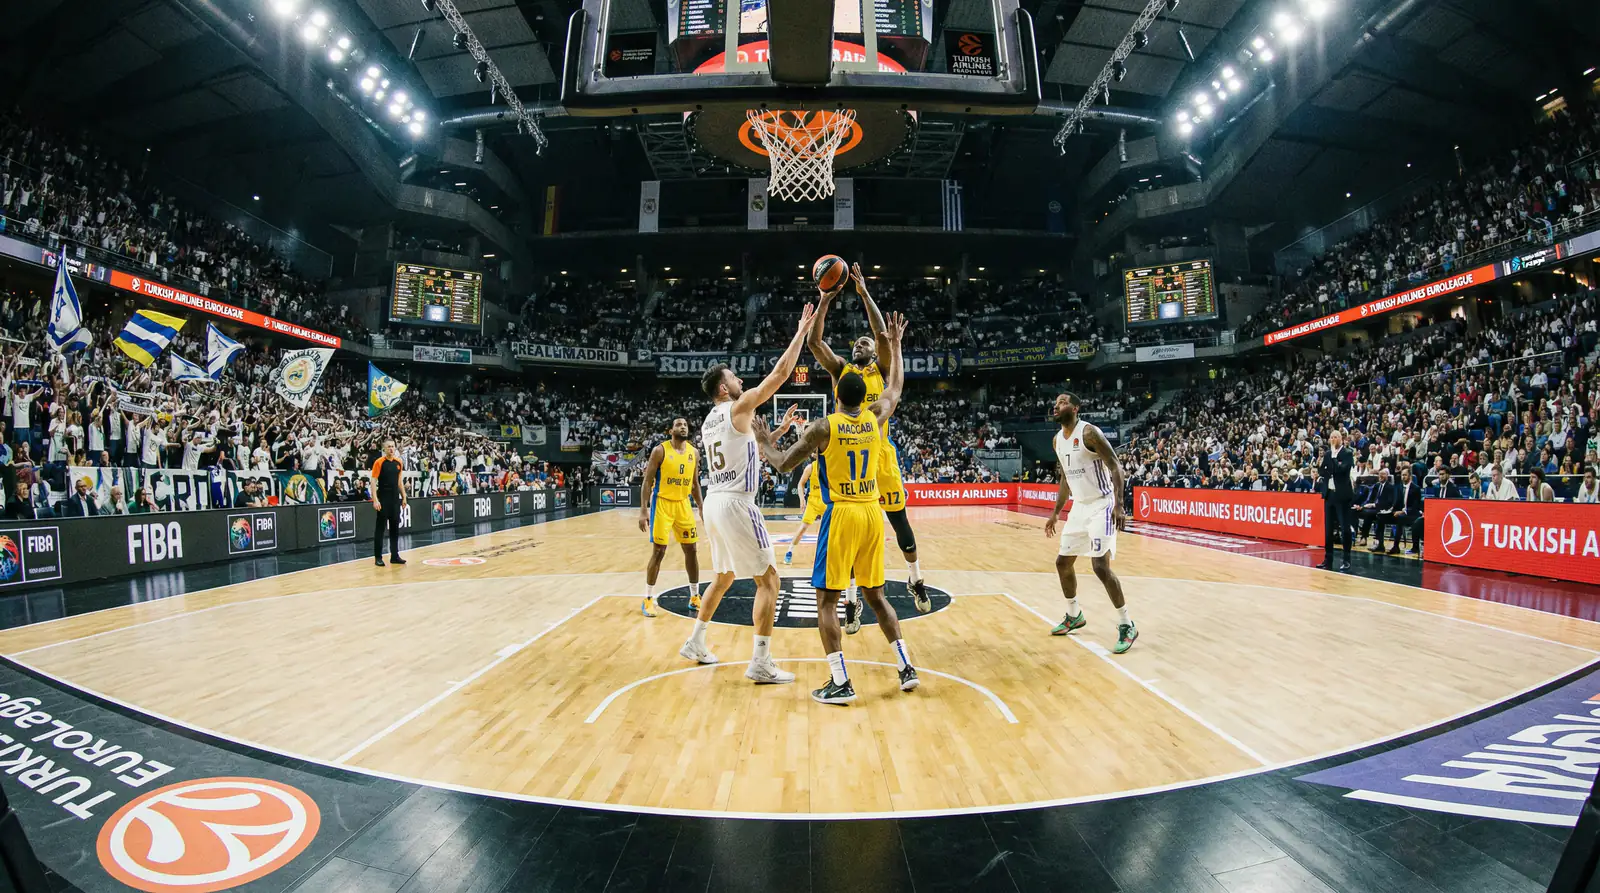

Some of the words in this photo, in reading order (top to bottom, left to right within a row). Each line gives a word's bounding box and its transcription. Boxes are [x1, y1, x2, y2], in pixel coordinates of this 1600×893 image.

[144, 282, 174, 300] TURKISH
[174, 291, 204, 308] AIRLINES
[205, 302, 244, 319] EUROLEAGUE
[1369, 299, 1396, 314] TURKISH
[1396, 288, 1426, 305] AIRLINES
[1426, 274, 1474, 296] EUROLEAGUE
[518, 343, 553, 358] REAL
[562, 347, 619, 362] MADRID
[838, 422, 874, 434] MACCABI
[708, 440, 726, 472] 15
[839, 482, 856, 495] TEL
[913, 489, 960, 499] TURKISH
[962, 488, 1008, 498] AIRLINES
[474, 497, 492, 517] FIBA
[1152, 498, 1187, 515] TURKISH
[1189, 502, 1230, 519] AIRLINES
[1233, 506, 1313, 528] EUROLEAGUE
[256, 517, 273, 531] FIBA
[28, 534, 54, 553] FIBA
[127, 521, 183, 565] FIBA
[1480, 523, 1576, 556] TURKISH
